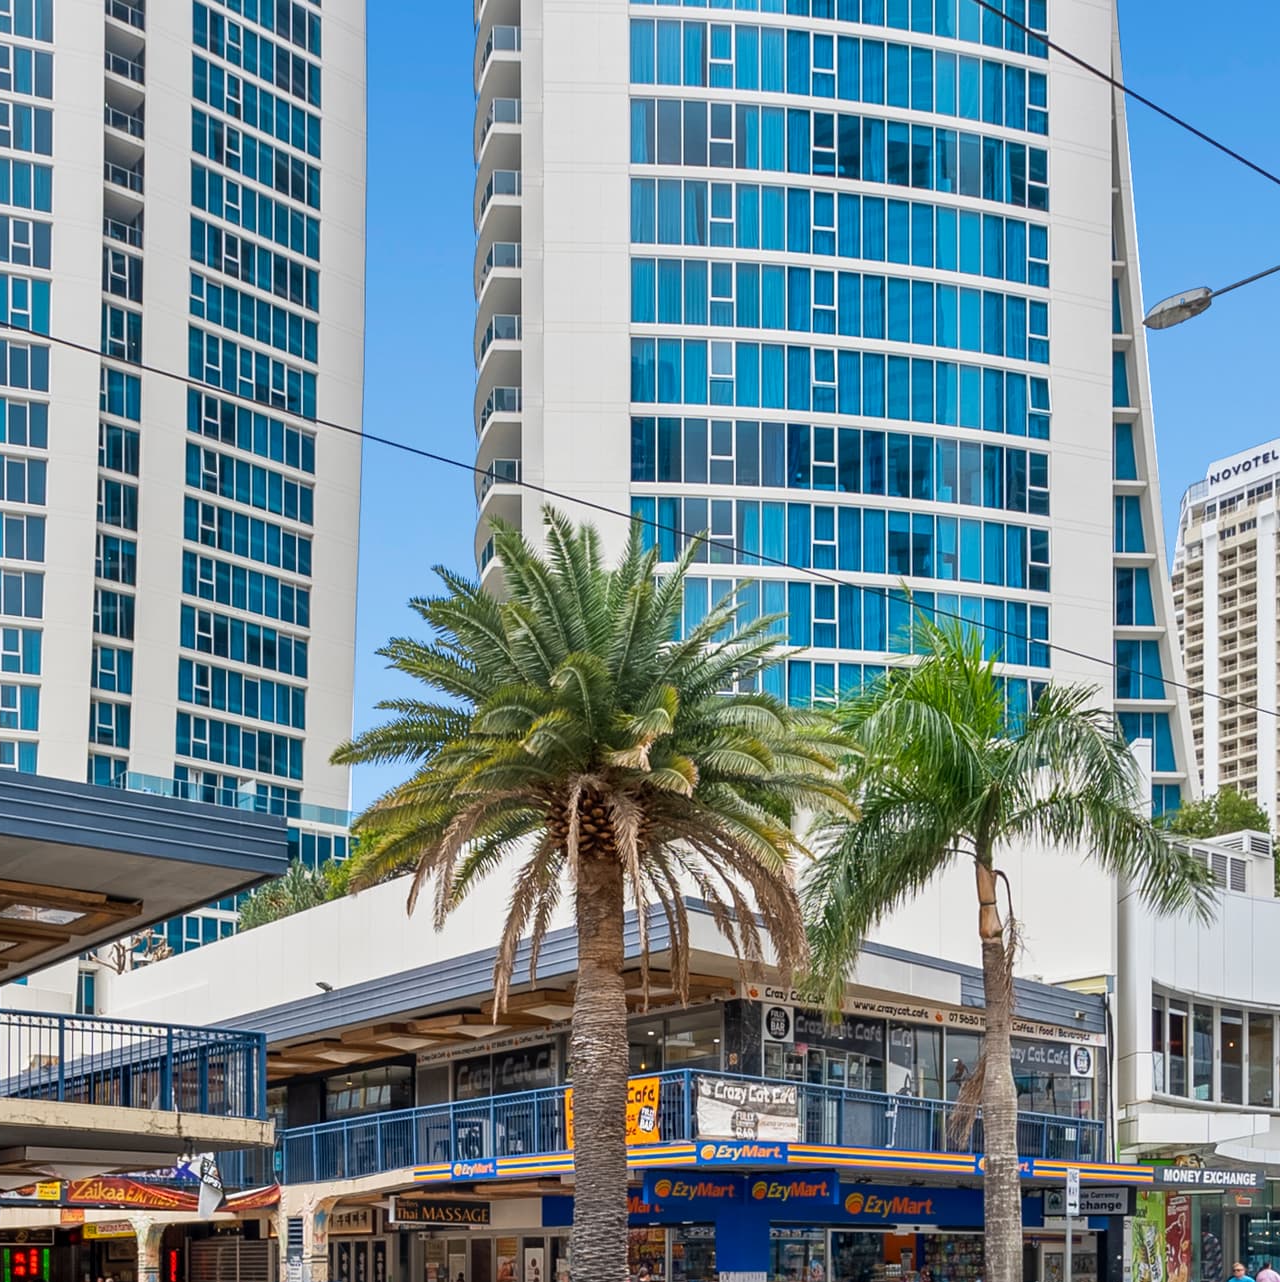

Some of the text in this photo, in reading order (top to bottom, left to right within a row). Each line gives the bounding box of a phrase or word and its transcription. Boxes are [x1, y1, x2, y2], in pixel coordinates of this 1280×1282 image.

[1209, 449, 1280, 486] NOVOTEL
[765, 986, 788, 1001] Crazy
[853, 1000, 929, 1020] www.crazycat.cafe
[770, 1021, 786, 1032] BAR
[855, 1023, 882, 1042] Café
[1011, 1022, 1091, 1042] Coffee Food Beverages
[1028, 1046, 1046, 1063] Cat
[1047, 1050, 1069, 1066] Café
[714, 1082, 796, 1105] Crazy Cat Café
[735, 1110, 755, 1121] FULLY
[640, 1119, 654, 1132] BAR
[1163, 1168, 1257, 1186] MONEY EXCHANGE
[71, 1178, 126, 1201] Zaikaa
[671, 1181, 735, 1200] EzyMart
[1090, 1191, 1120, 1200] Currency
[627, 1195, 664, 1213] Mart
[1080, 1201, 1122, 1212] change
[397, 1206, 489, 1223] Thai MASSAGE
